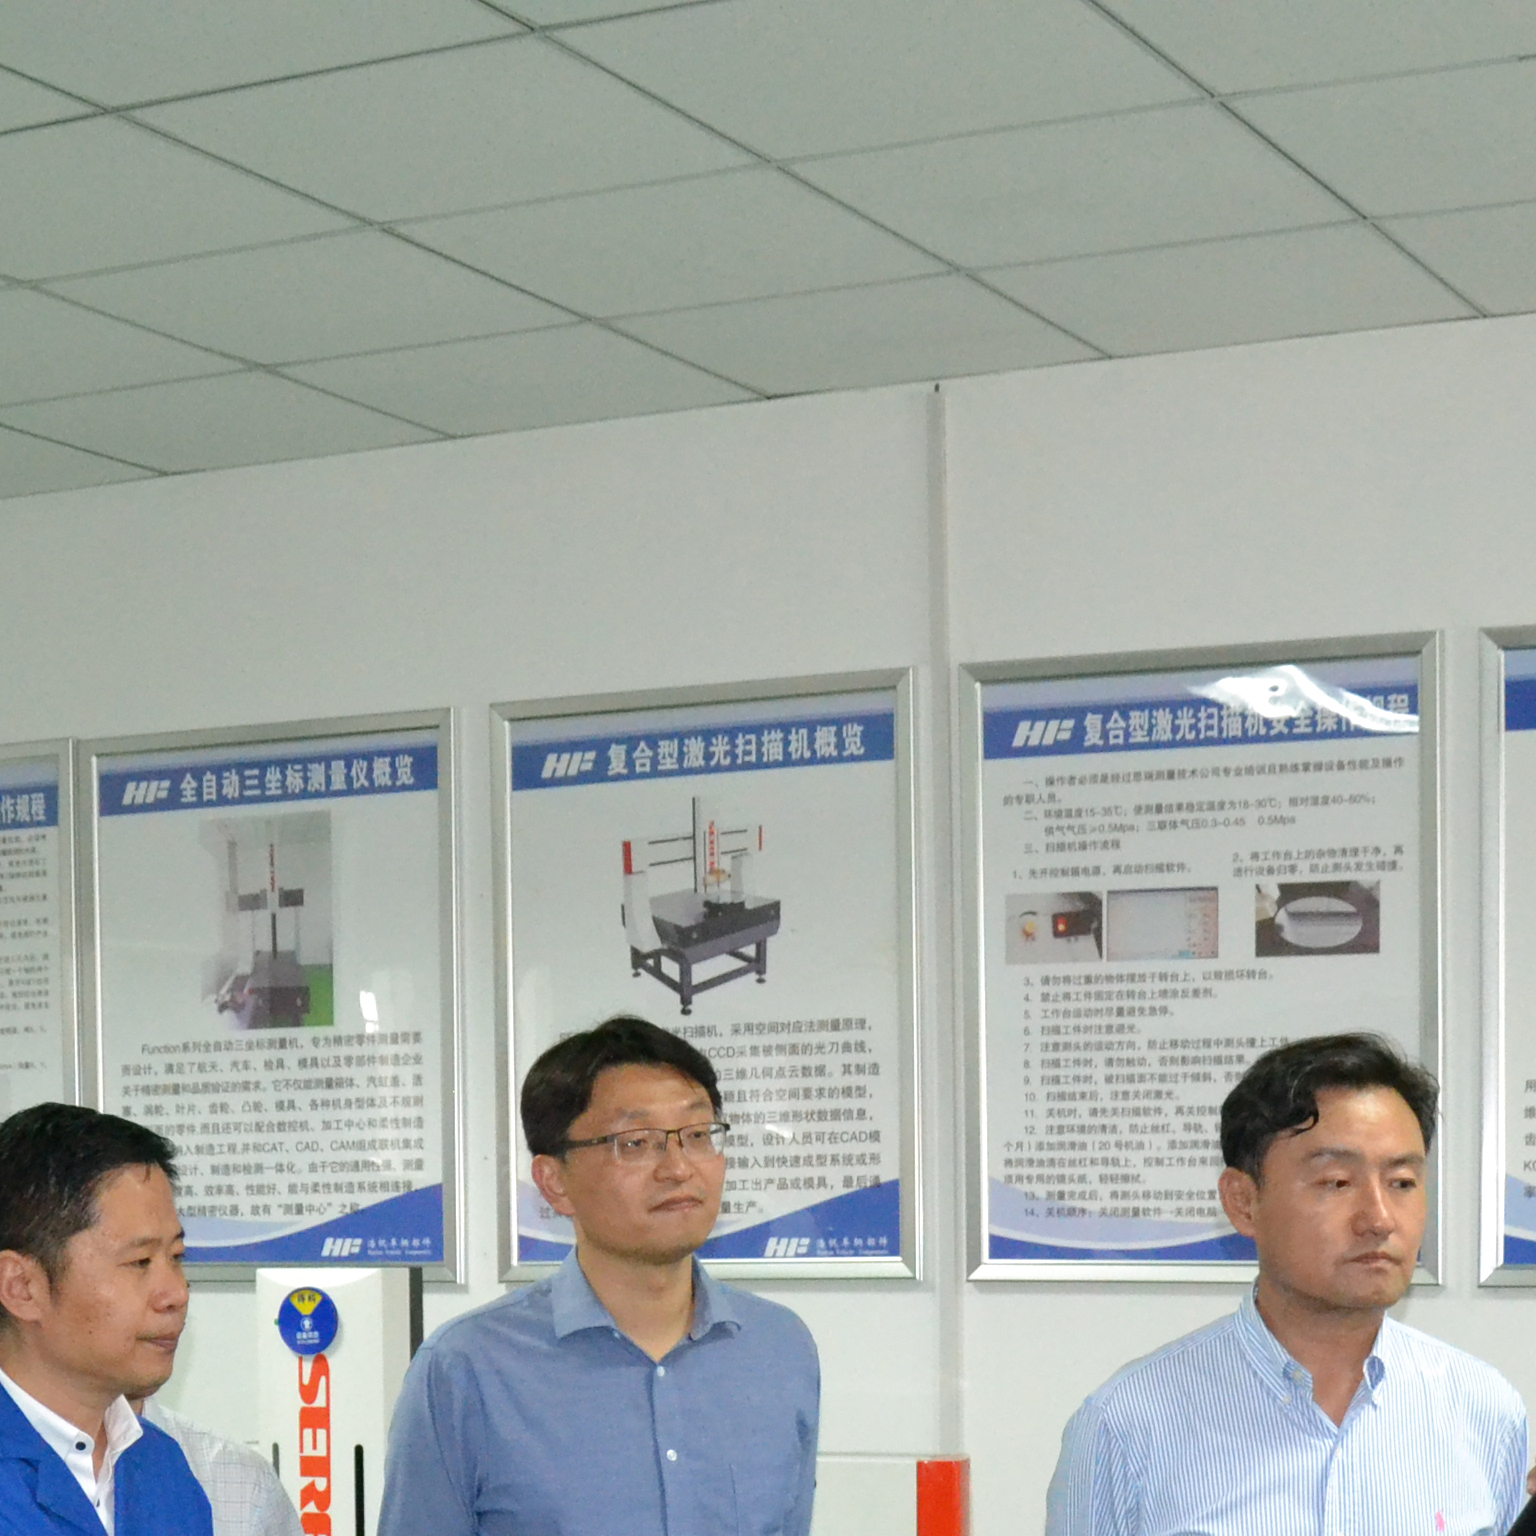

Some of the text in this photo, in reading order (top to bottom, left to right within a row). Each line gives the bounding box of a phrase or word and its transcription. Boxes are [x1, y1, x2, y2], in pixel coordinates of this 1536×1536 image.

[606, 722, 865, 777] 复合型激光扫描机概览
[180, 753, 415, 803] 全自动三坐标测量仪概览
